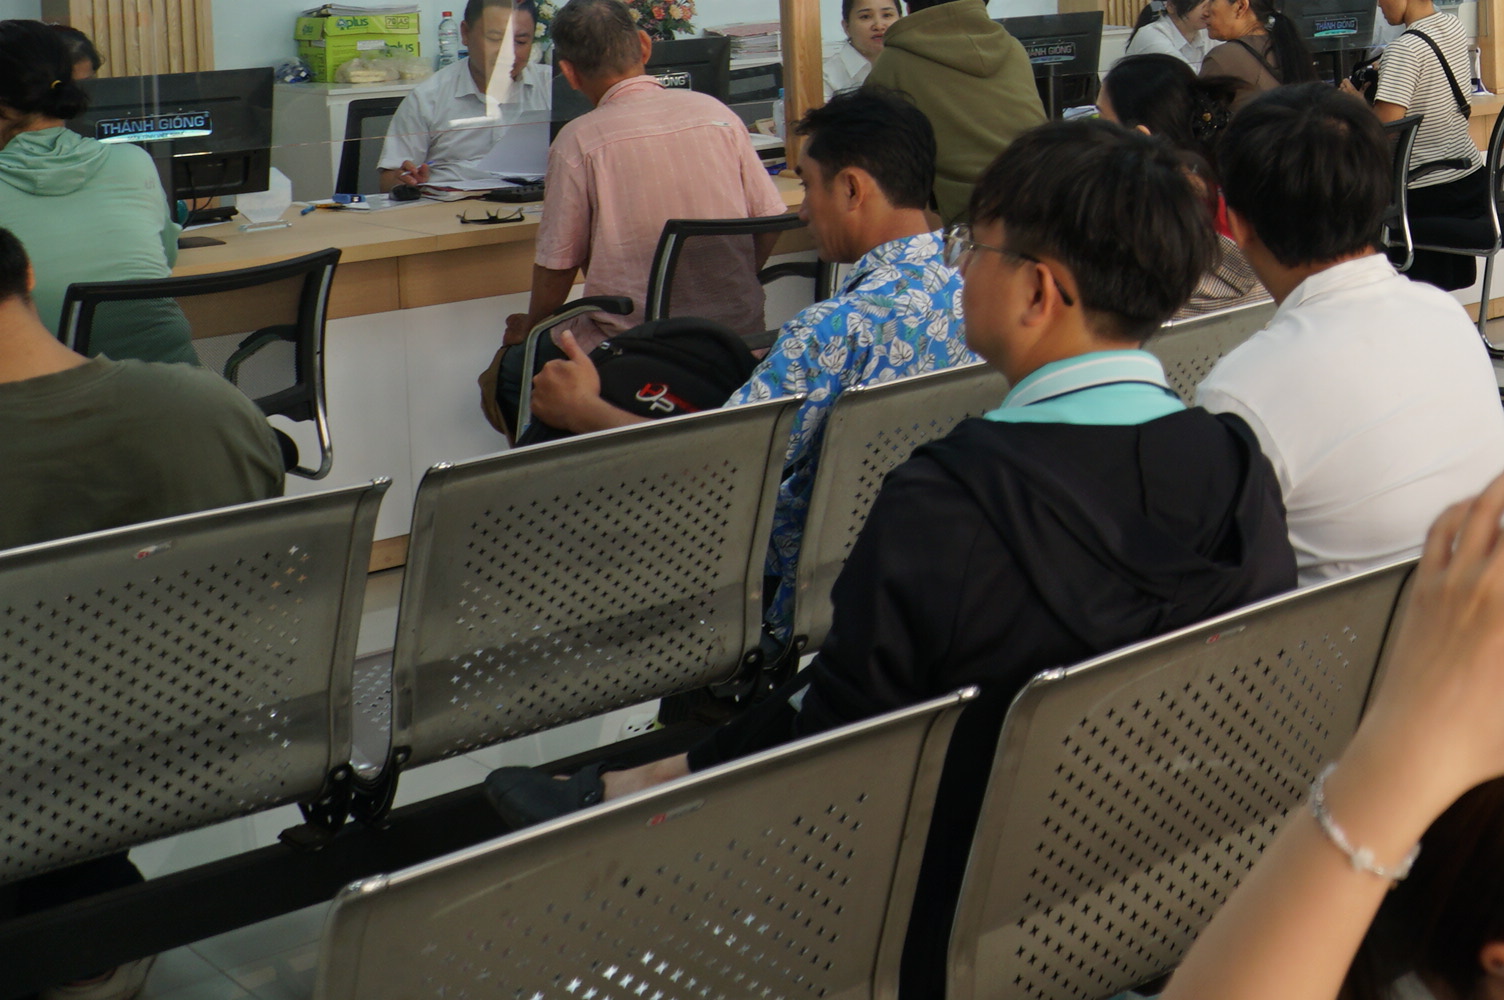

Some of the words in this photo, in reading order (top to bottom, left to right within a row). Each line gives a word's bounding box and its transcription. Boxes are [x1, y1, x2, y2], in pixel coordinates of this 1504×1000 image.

[1316, 22, 1336, 31] THÁNH
[1048, 44, 1072, 55] GIÓNG
[101, 120, 154, 135] THÁNH
[158, 115, 205, 130] GIÓNG
